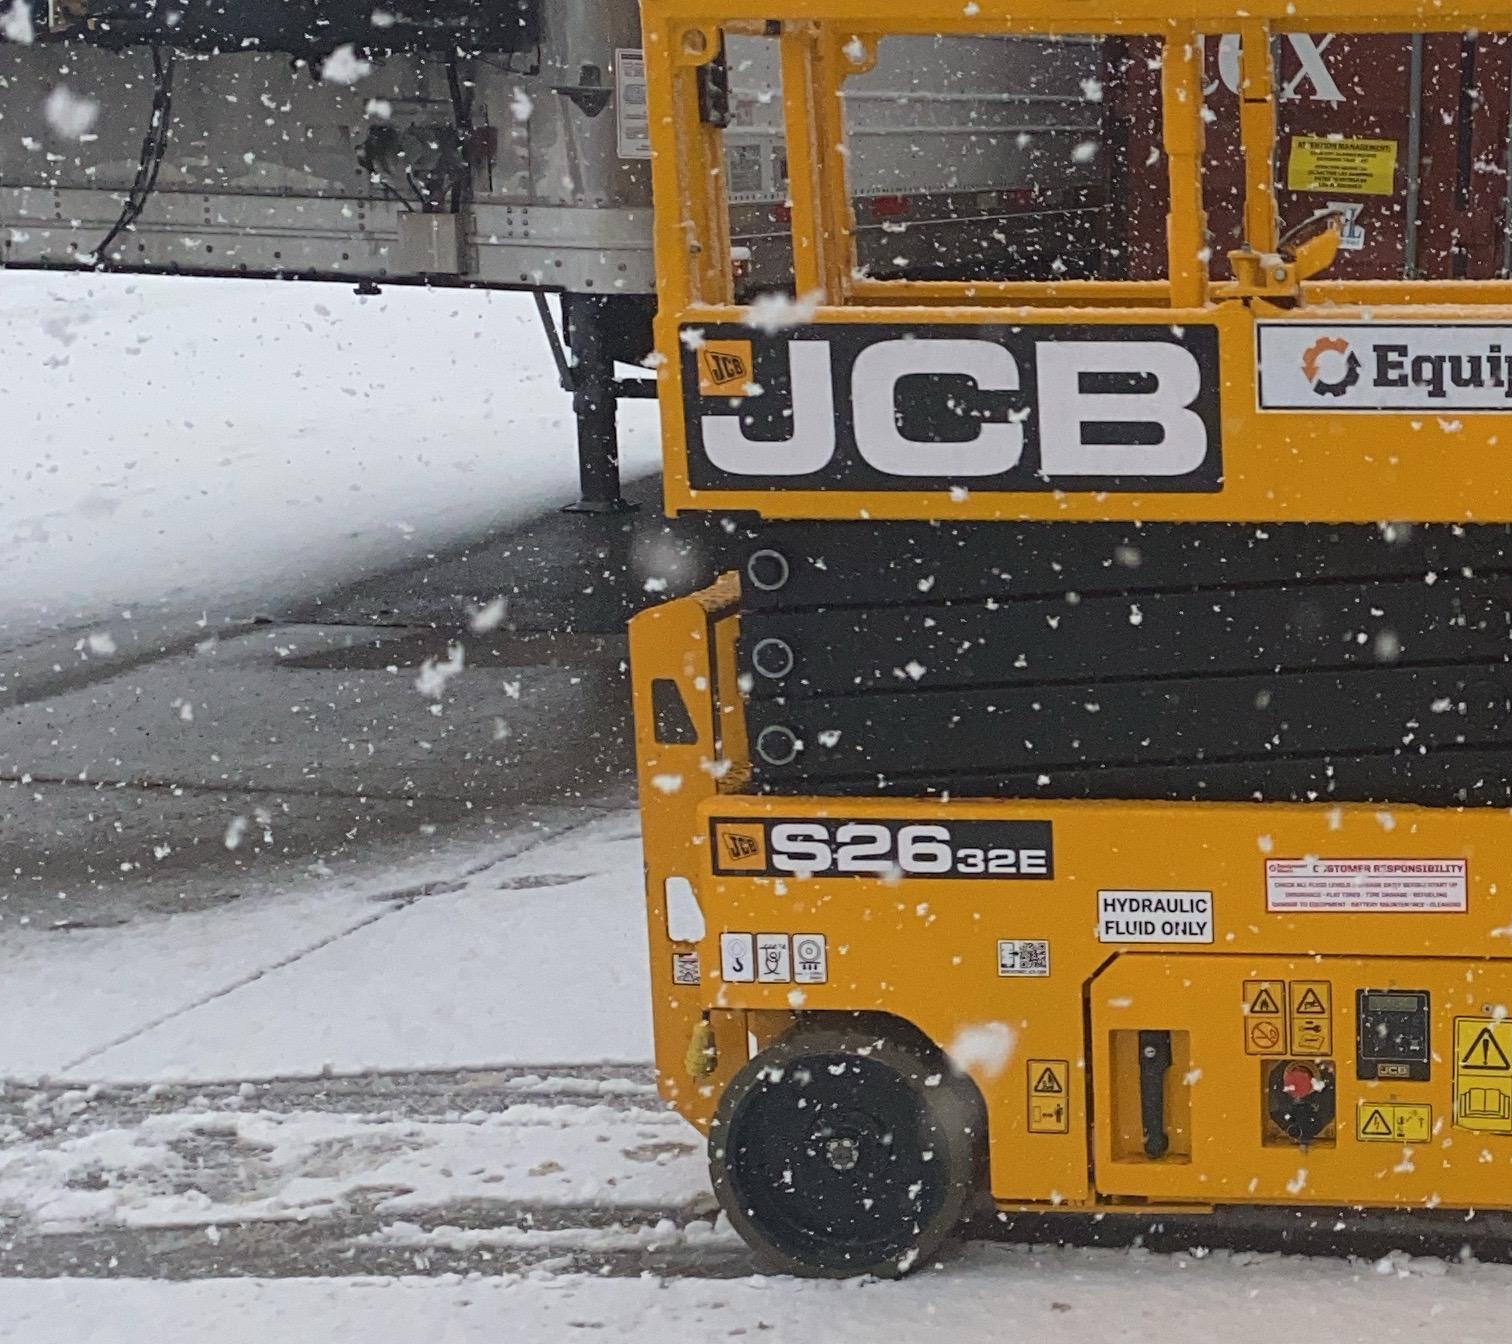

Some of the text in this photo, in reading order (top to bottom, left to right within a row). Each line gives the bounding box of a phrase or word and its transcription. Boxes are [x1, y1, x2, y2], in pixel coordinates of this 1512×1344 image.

[711, 354, 744, 381] JCB
[701, 339, 1209, 477] JCB
[771, 822, 1049, 876] S26 32E
[1103, 898, 1208, 914] HYDRAULIC
[1105, 920, 1208, 936] FLUID ONLY
